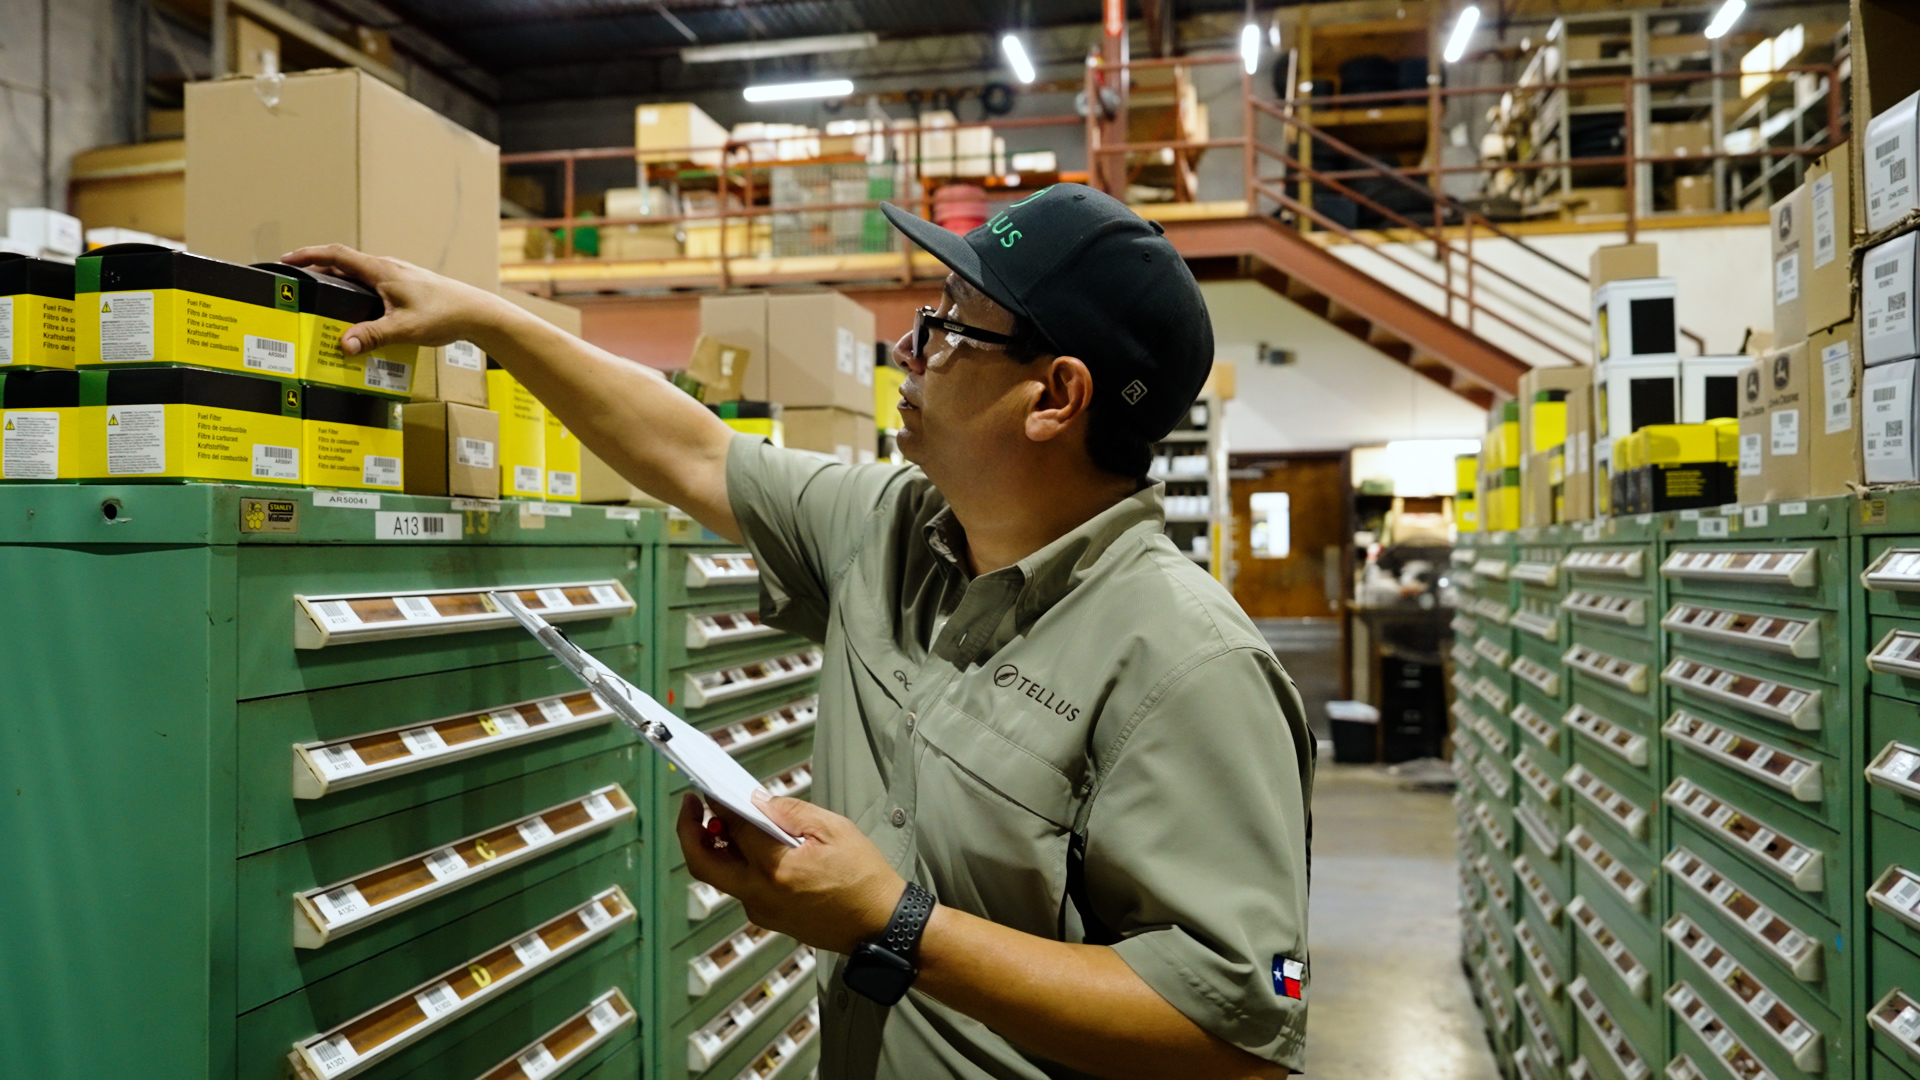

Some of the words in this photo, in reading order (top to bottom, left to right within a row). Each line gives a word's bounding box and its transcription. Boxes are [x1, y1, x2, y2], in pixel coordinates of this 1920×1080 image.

[43, 303, 57, 312] Fuel
[57, 305, 74, 314] Filter
[187, 299, 198, 307] Fuel
[199, 301, 212, 309] Filter
[43, 313, 60, 322] Filtro
[60, 315, 69, 323] de
[187, 308, 201, 317] Filtro
[201, 311, 208, 319] de
[209, 313, 238, 323] combustible
[43, 323, 60, 332] Filtre
[187, 318, 200, 327] Filtre
[205, 322, 229, 331] carburant
[43, 342, 60, 350] Filtro
[187, 338, 201, 347] Filtro
[201, 340, 209, 348] del
[210, 341, 240, 352] combustible
[268, 351, 288, 359] AR50041
[279, 365, 293, 373] DEERE
[198, 412, 208, 420] Fuel
[198, 422, 211, 430] Filtro
[212, 423, 218, 431] de
[219, 424, 247, 434] combustible
[198, 432, 211, 440] Filtre
[216, 434, 239, 443] carburant
[198, 452, 211, 460] Filtro
[220, 453, 249, 463] combustible
[329, 496, 368, 505] AR50041
[270, 503, 292, 511] STANLEY
[268, 514, 292, 523] Vidmar
[393, 516, 418, 536] A13
[1016, 676, 1080, 722] TELLUS
[334, 762, 354, 771] A13B1
[475, 839, 496, 860] C
[443, 863, 458, 875] A13C2
[338, 904, 357, 916] A13C1
[468, 964, 491, 988] D
[325, 1057, 347, 1071] A13D1
